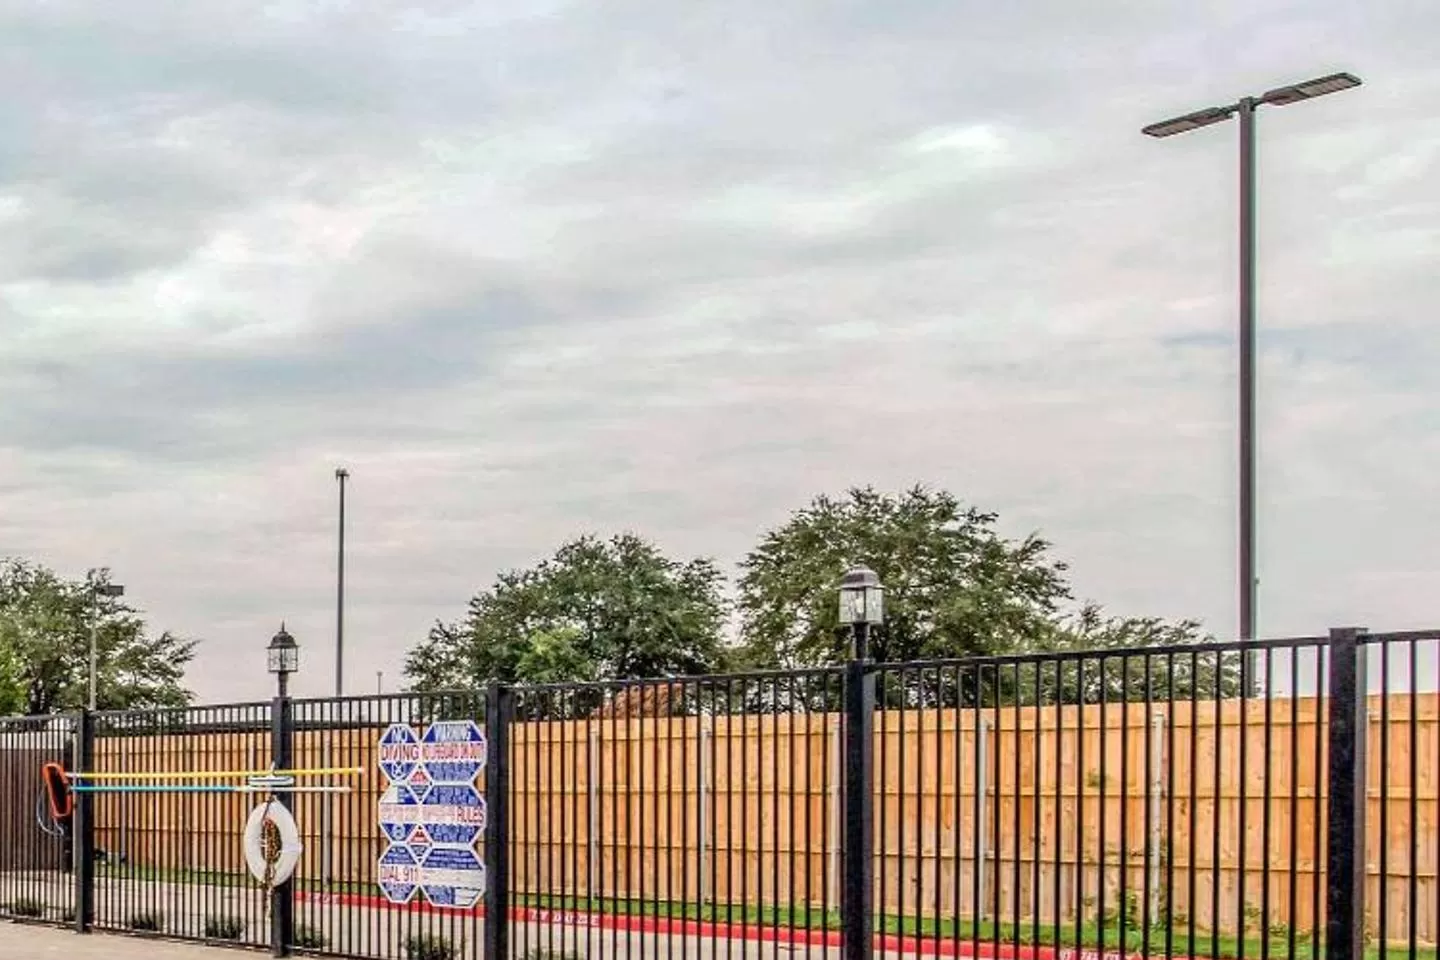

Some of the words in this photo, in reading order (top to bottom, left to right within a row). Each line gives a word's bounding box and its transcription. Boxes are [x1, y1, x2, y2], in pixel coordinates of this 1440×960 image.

[391, 726, 409, 742] NO
[380, 744, 419, 760] DIVING
[456, 806, 484, 823] RULES
[403, 867, 419, 882] 911
